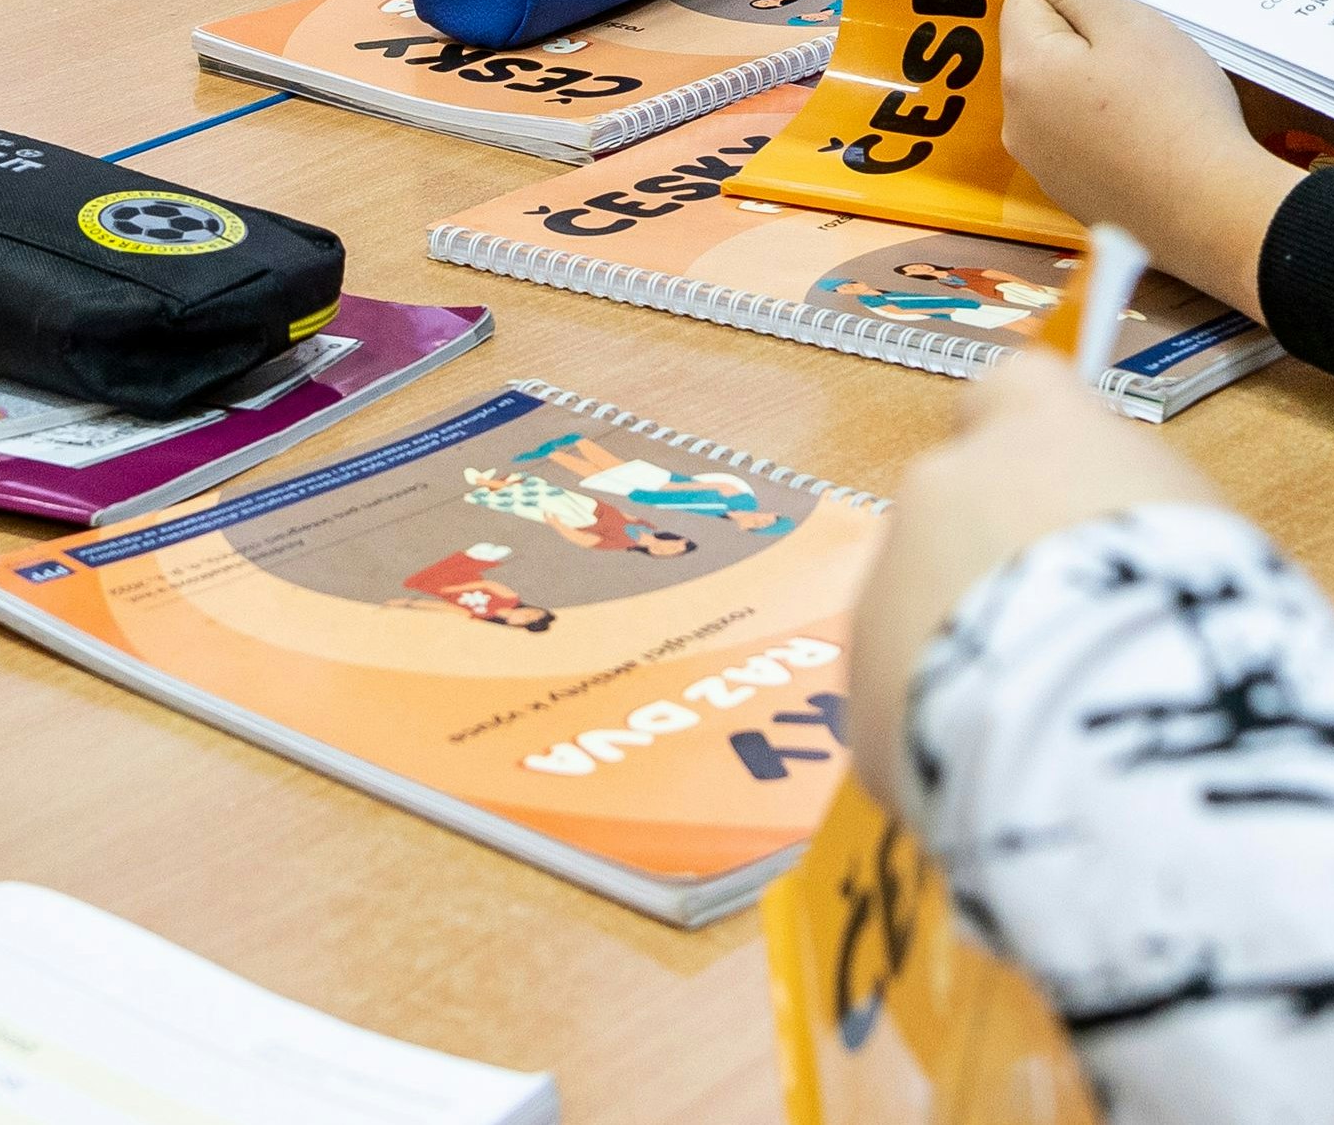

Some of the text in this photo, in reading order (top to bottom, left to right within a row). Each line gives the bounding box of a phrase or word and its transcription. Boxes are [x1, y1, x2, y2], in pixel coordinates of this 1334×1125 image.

[1295, 2, 1317, 17] To
[682, 636, 842, 710] RAZ
[521, 699, 702, 777] DVA
